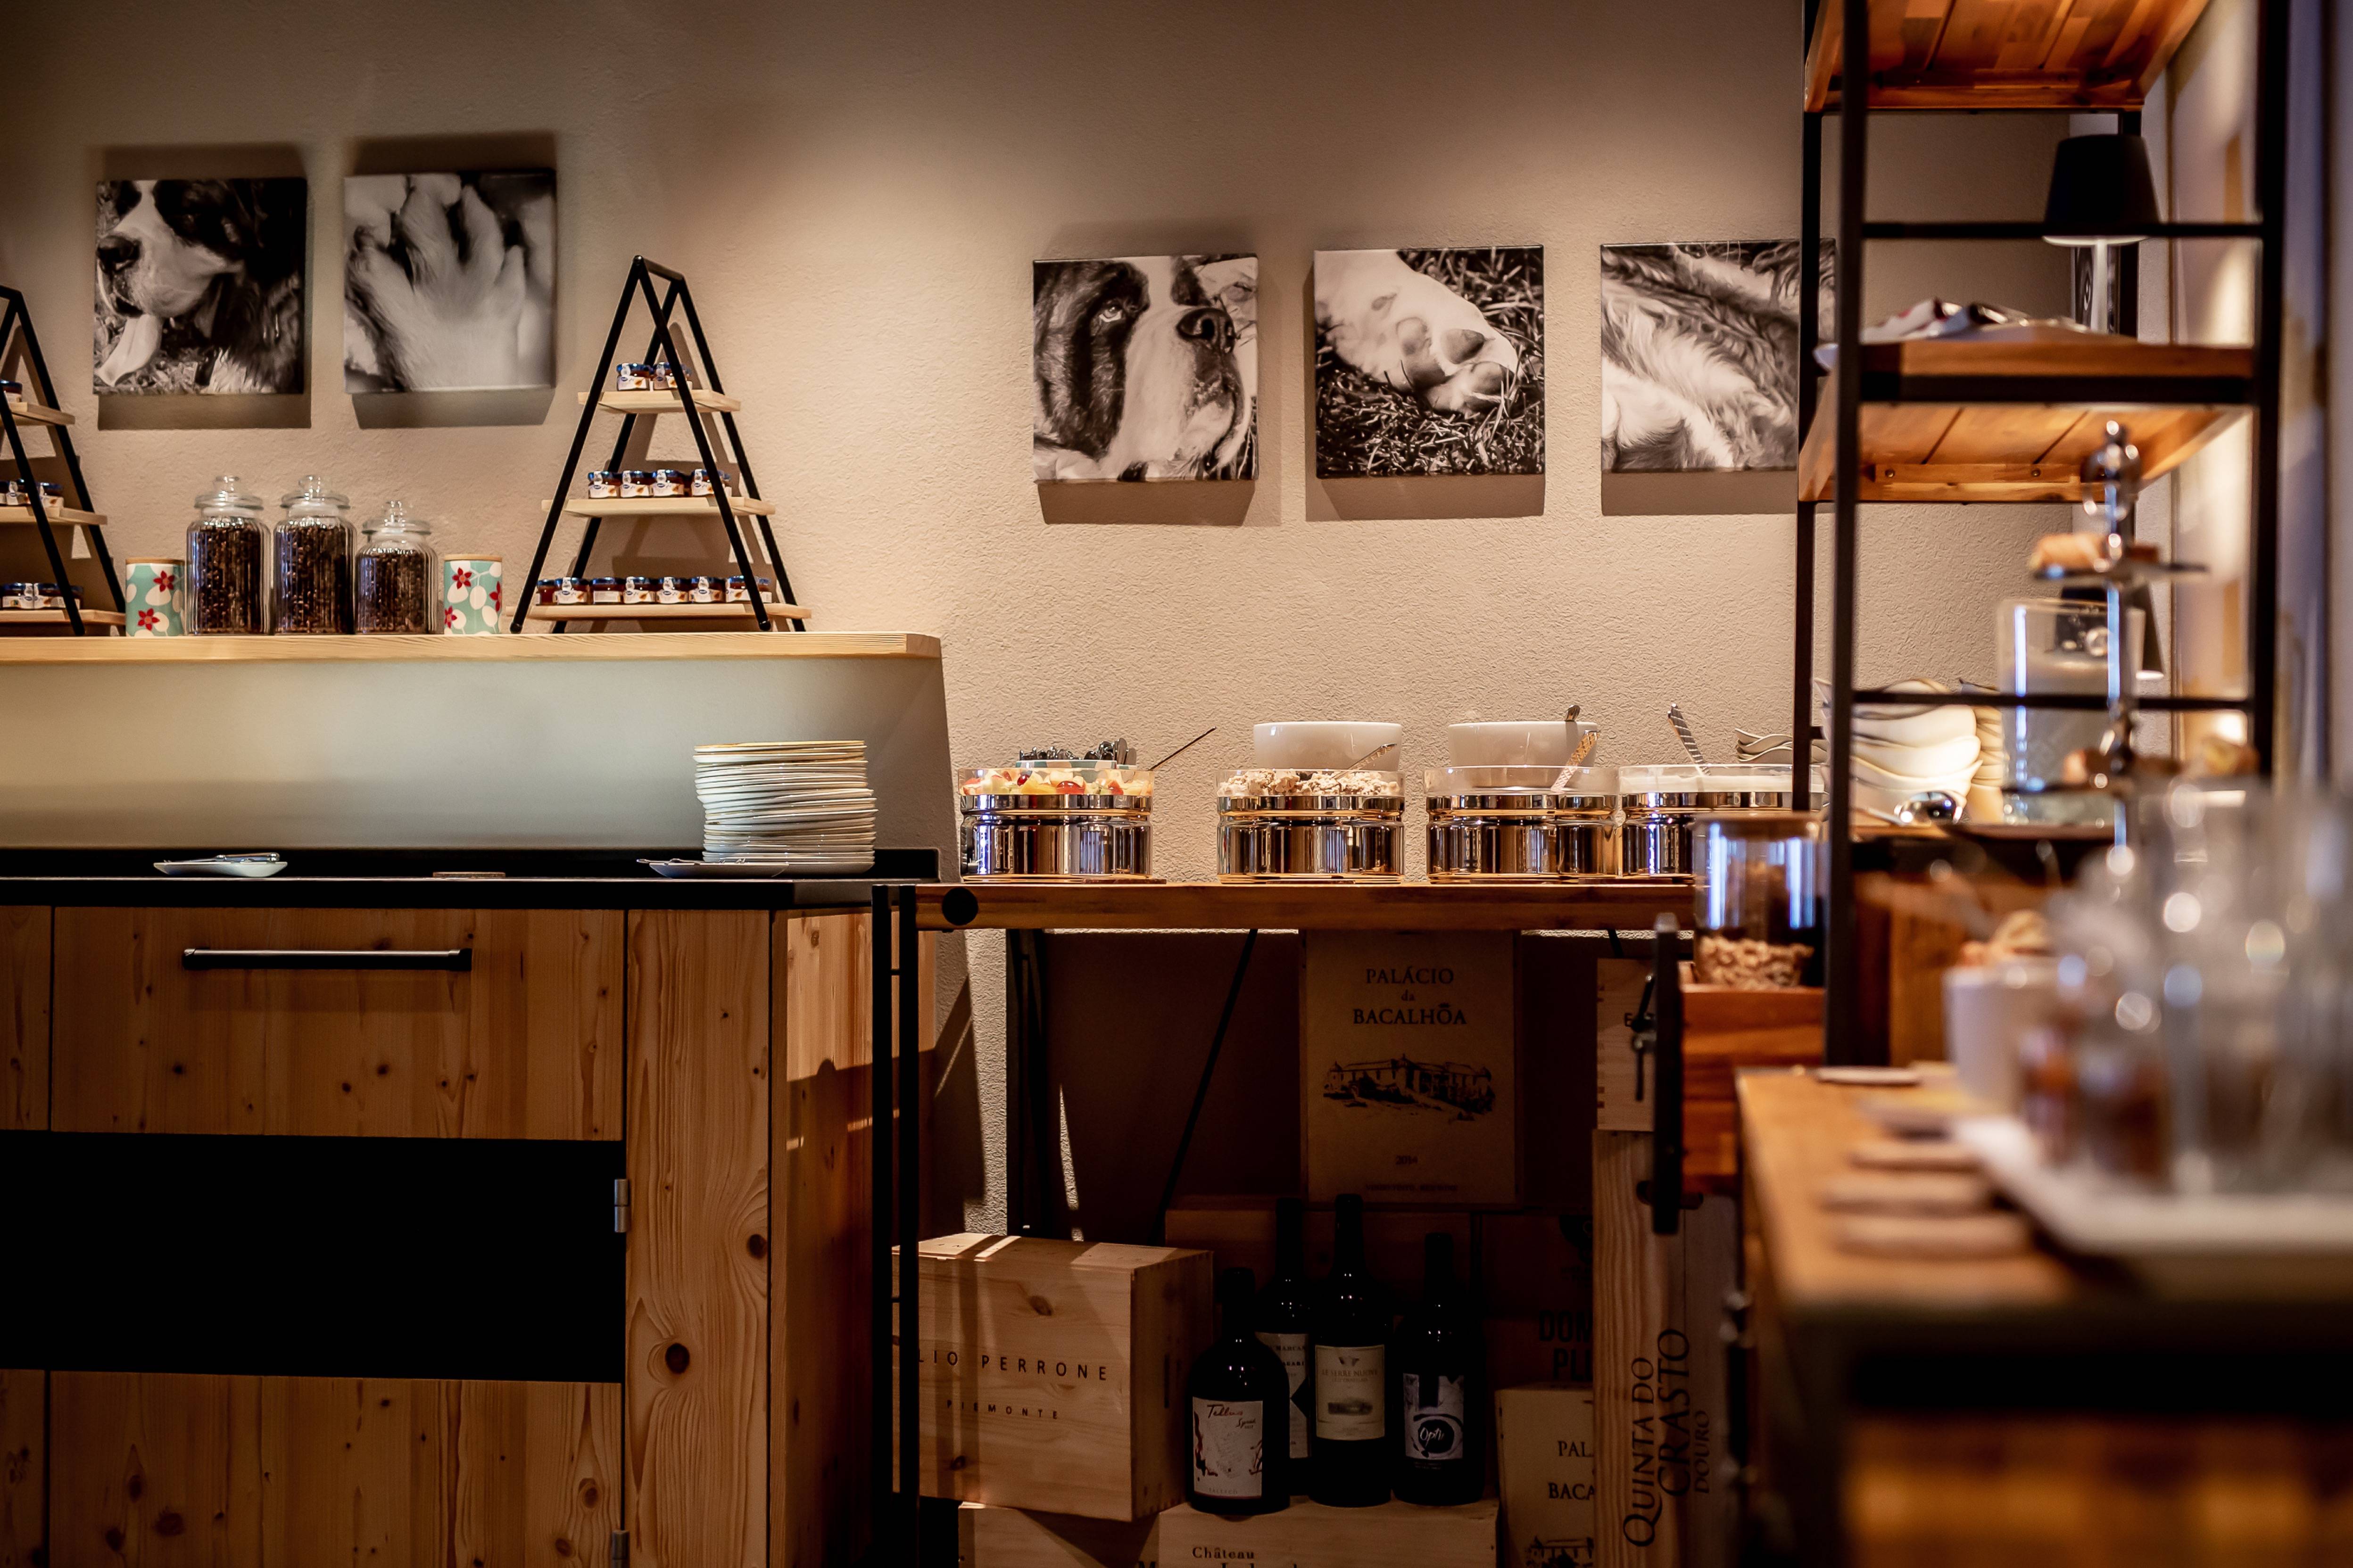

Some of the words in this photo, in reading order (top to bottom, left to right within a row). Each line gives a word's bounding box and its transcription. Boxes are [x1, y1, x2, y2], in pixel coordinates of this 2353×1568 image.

[1366, 966, 1454, 984] PALÁCIO
[1401, 989, 1415, 1001] da
[981, 1354, 1107, 1381] PERRONE
[1631, 1358, 1654, 1404] DO
[947, 1399, 1058, 1419] PIEMONTE
[1657, 1329, 1691, 1497] CRASTO
[1558, 1440, 1594, 1457] PAL
[1695, 1410, 1710, 1494] DOURO
[1623, 1417, 1662, 1547] QUINTA
[1193, 1546, 1255, 1559] Château
